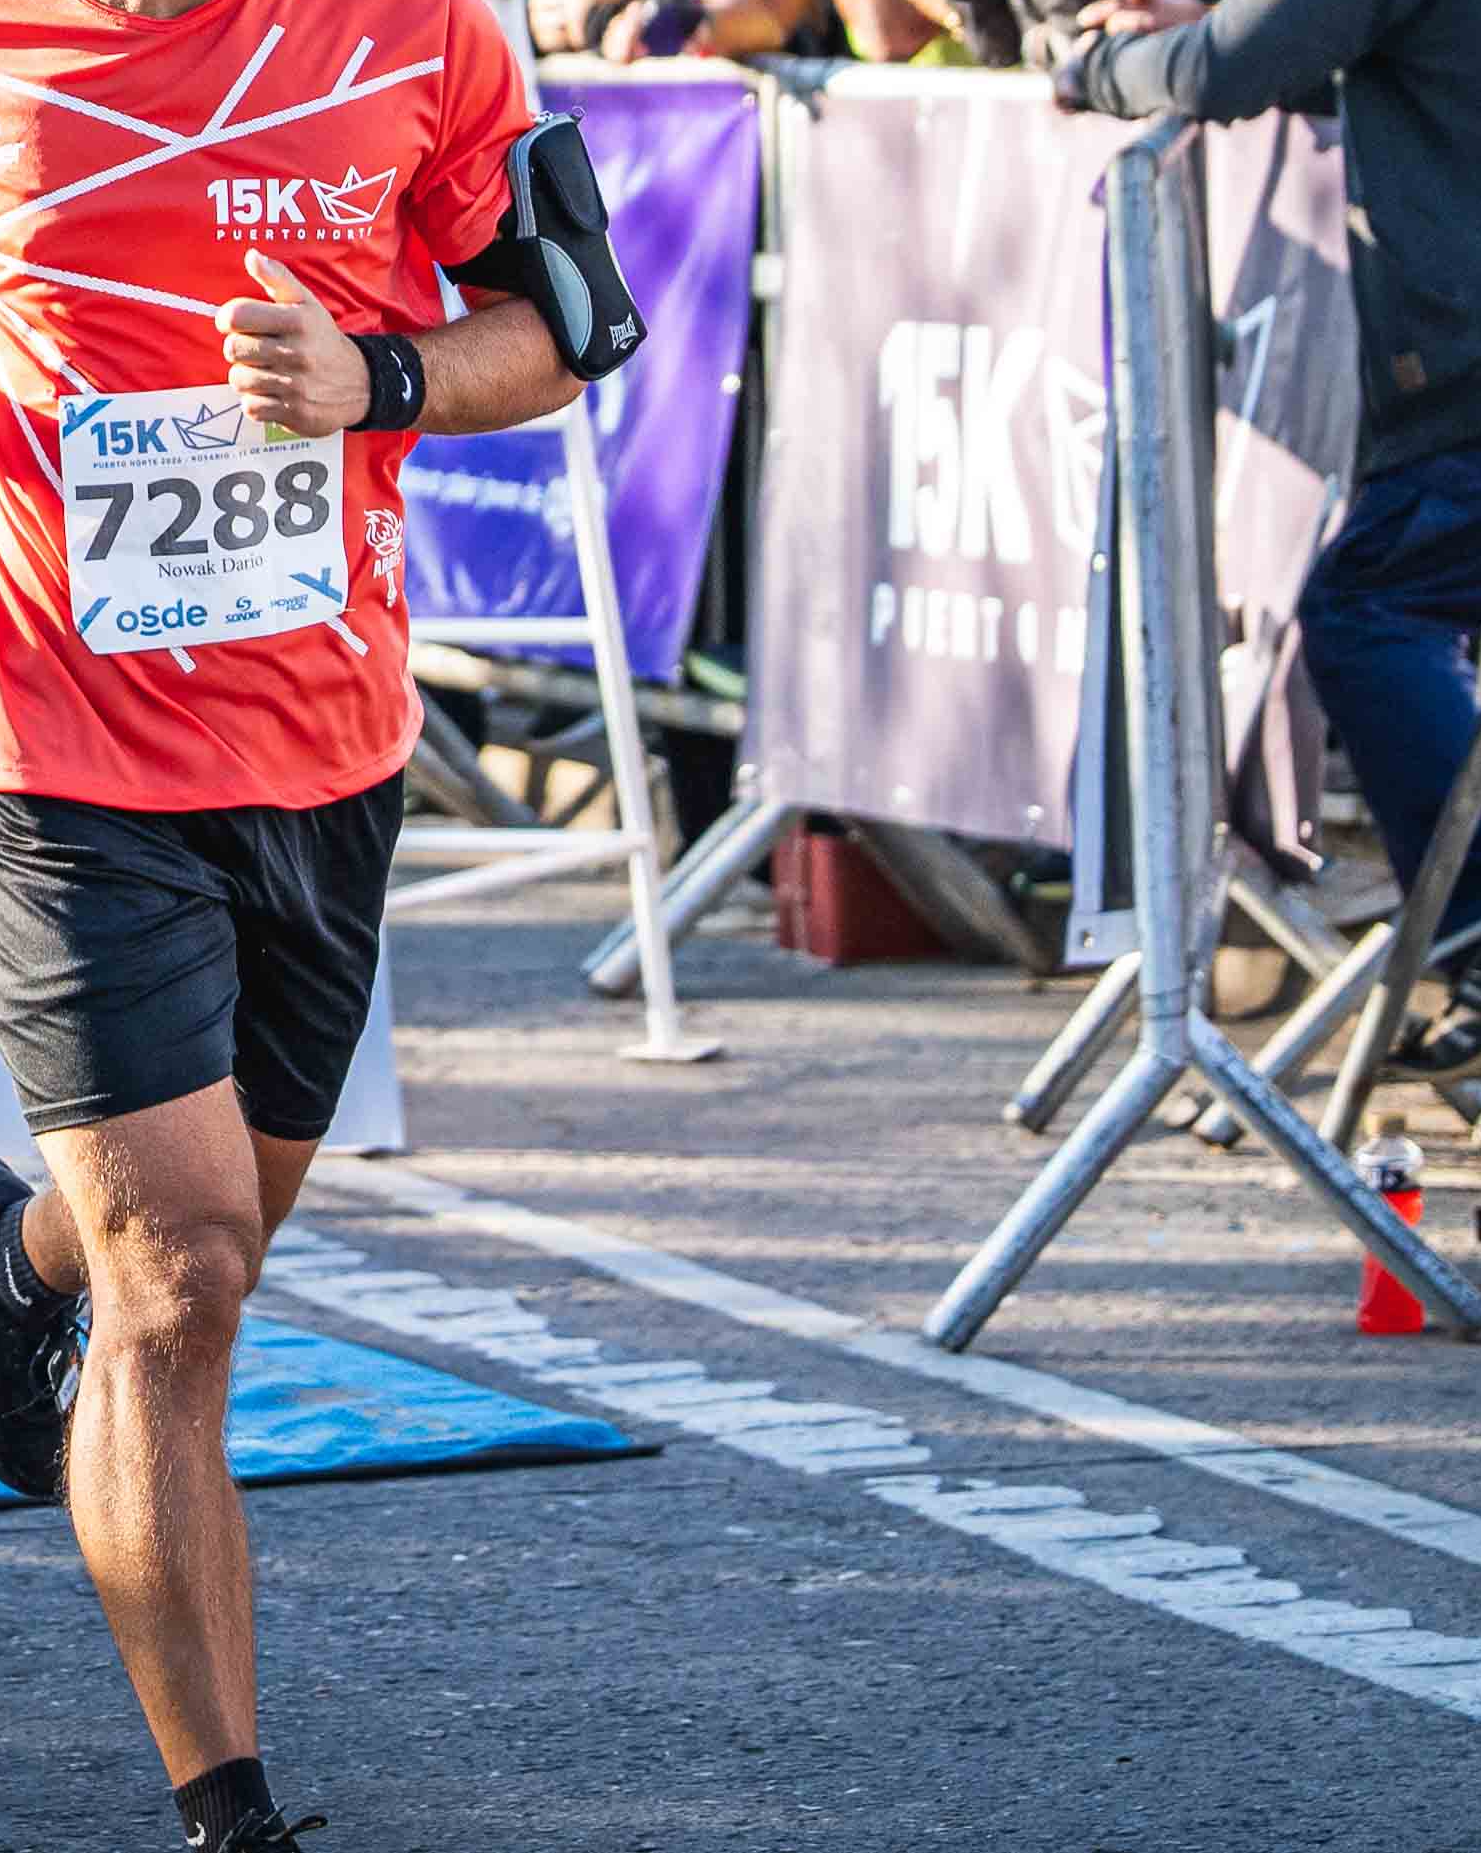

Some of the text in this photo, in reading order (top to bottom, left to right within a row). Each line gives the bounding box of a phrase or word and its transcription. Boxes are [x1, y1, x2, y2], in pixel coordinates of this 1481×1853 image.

[206, 178, 307, 225] 15K
[216, 227, 307, 241] PUERTO
[90, 417, 168, 457] 15K
[879, 321, 1045, 565] 15K
[93, 459, 127, 469] PUERTO
[129, 457, 158, 468] NORTE
[75, 460, 330, 562] 7288
[157, 558, 217, 579] Nowak
[115, 598, 209, 637] osde
